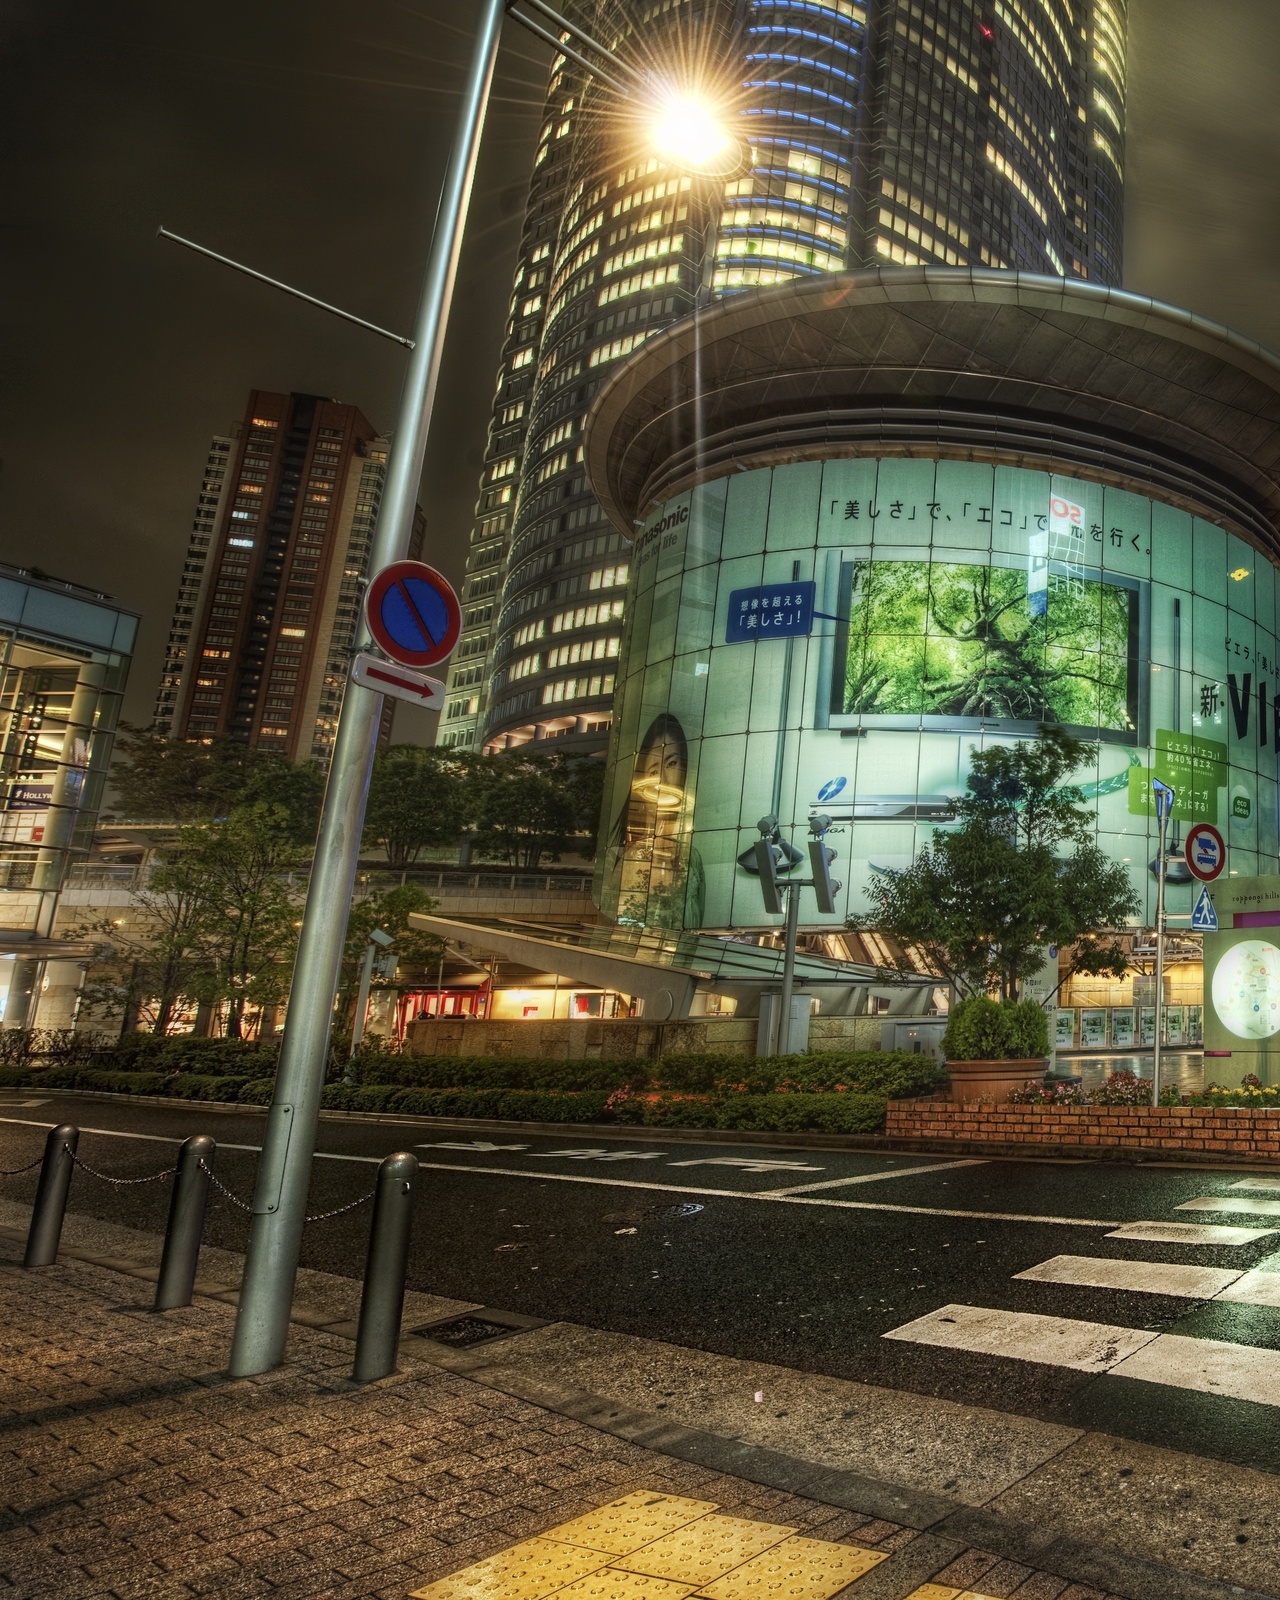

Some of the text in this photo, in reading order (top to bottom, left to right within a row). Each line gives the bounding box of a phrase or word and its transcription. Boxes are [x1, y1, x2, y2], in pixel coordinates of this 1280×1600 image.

[663, 533, 678, 550] life
[740, 594, 803, 612] 想像を超える
[1237, 799, 1248, 808] eco
[1235, 806, 1249, 816] ideas
[1265, 891, 1280, 899] hills
